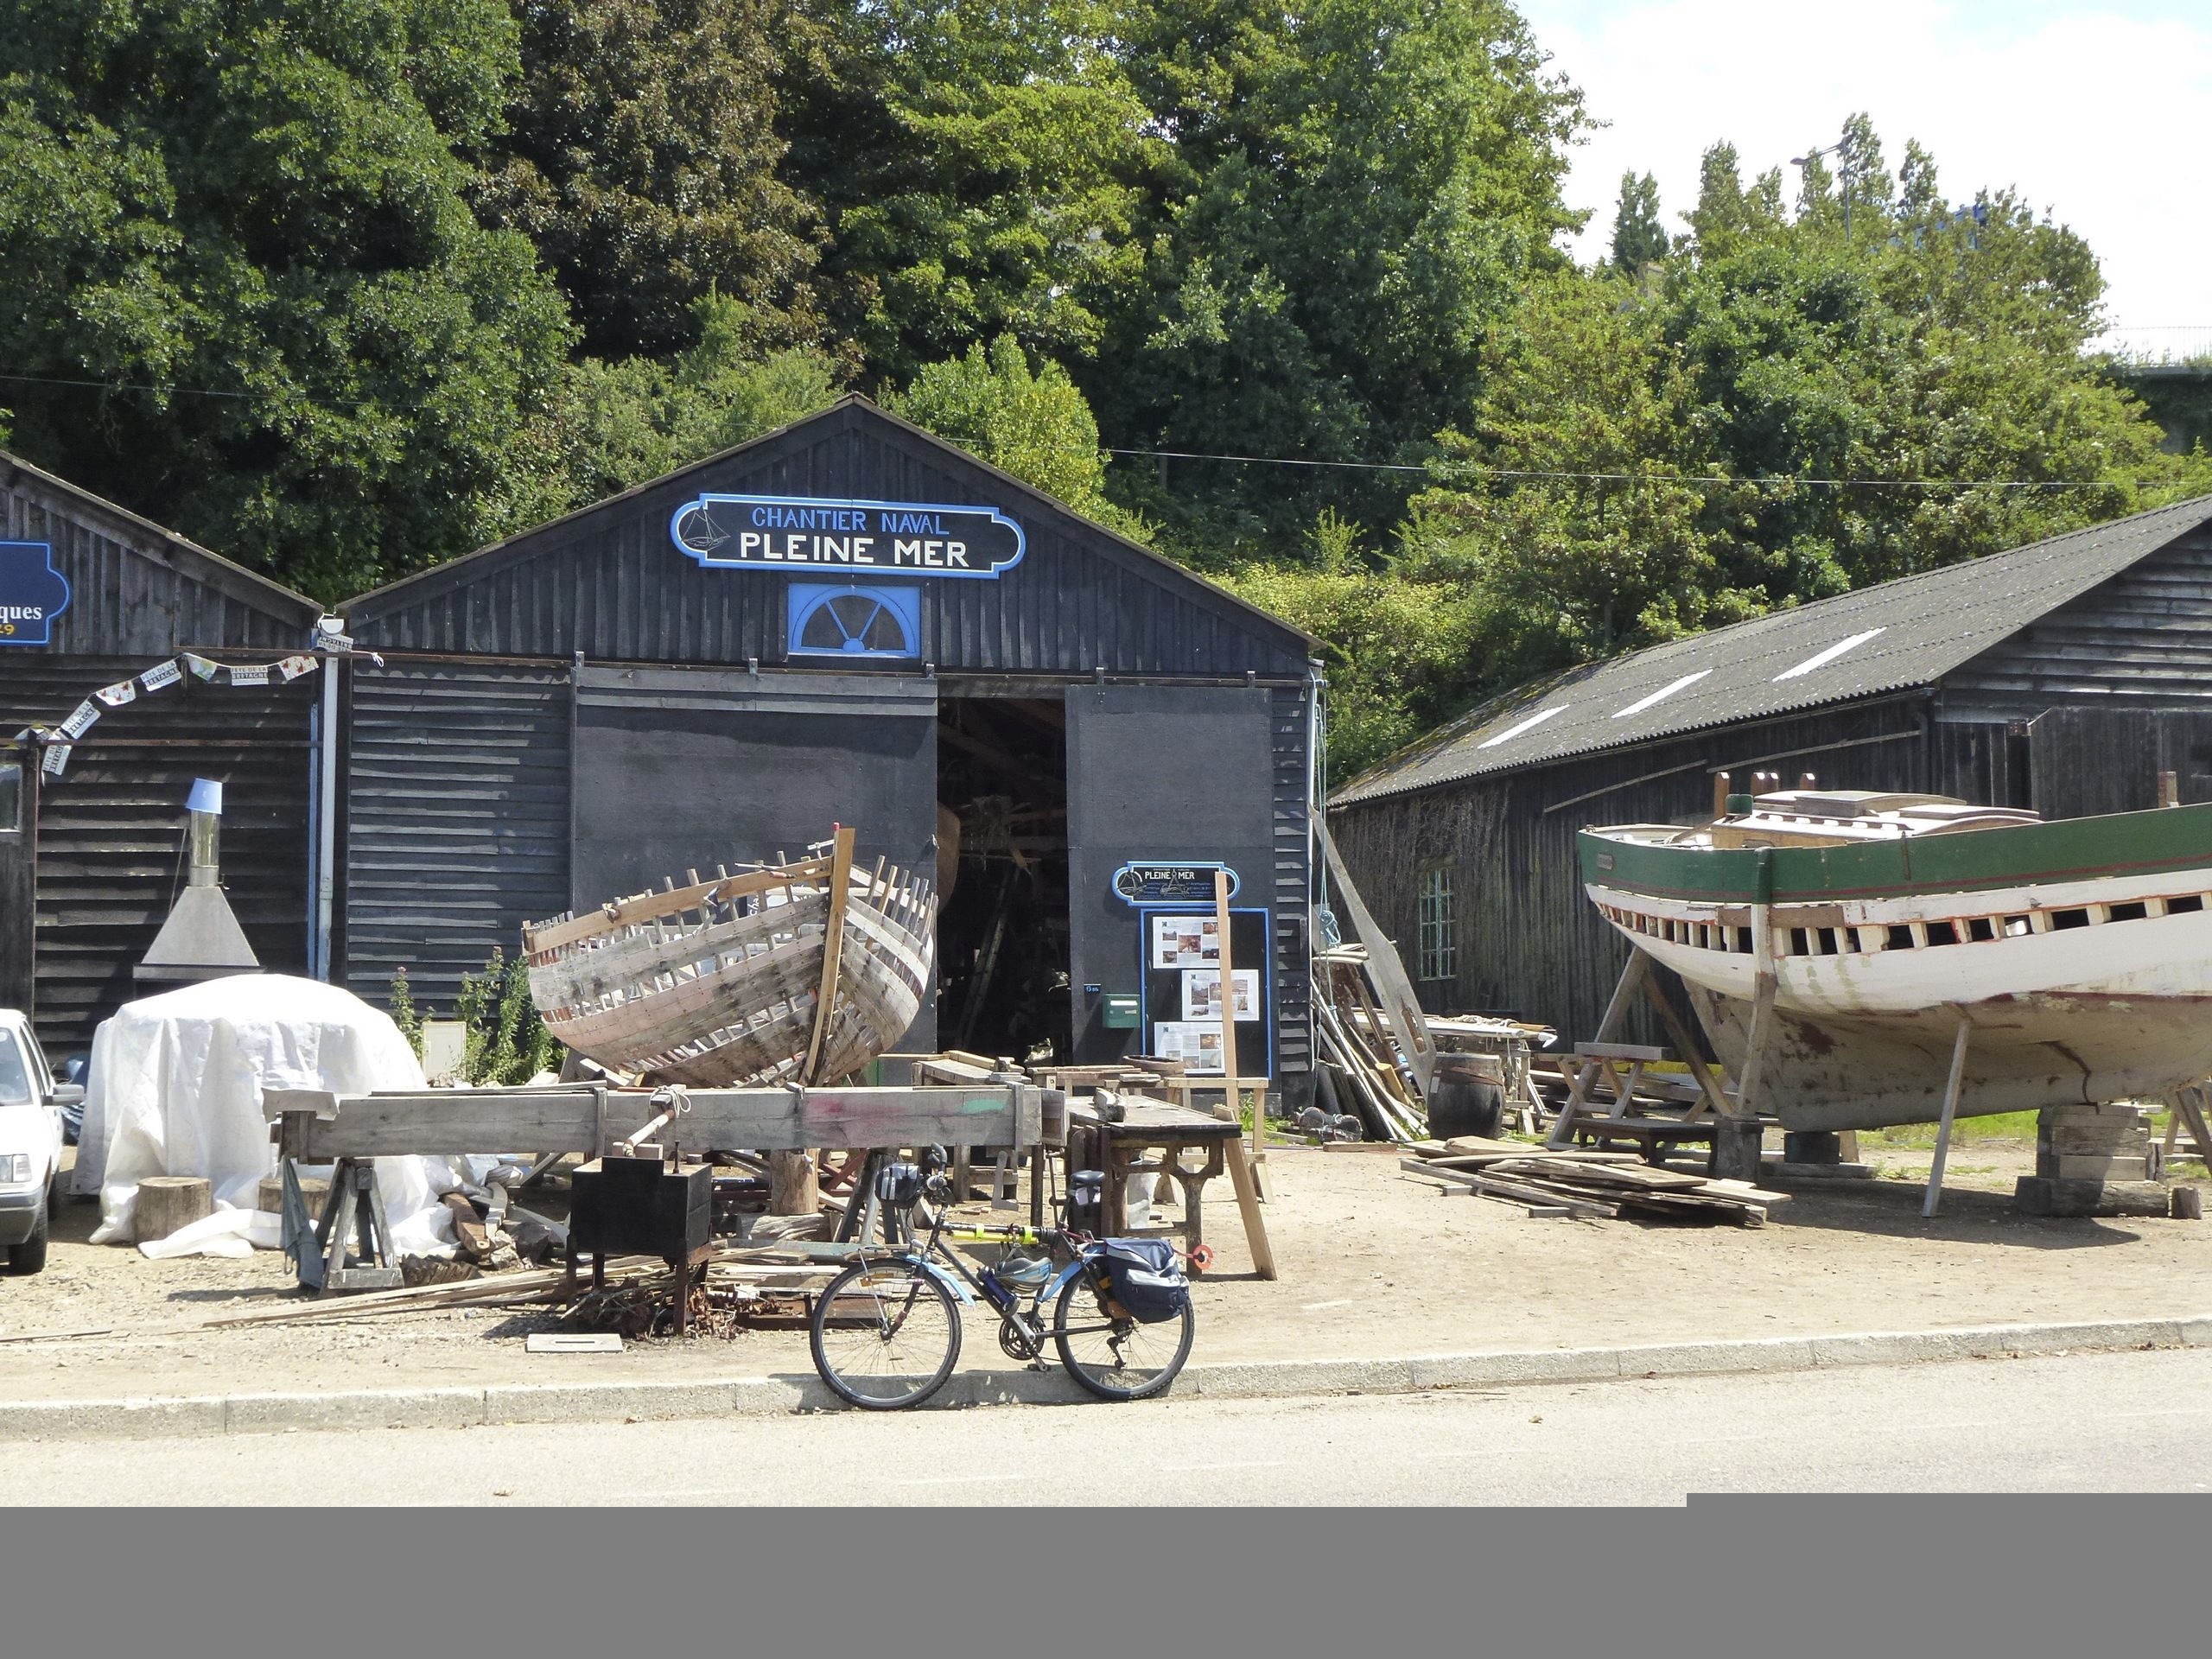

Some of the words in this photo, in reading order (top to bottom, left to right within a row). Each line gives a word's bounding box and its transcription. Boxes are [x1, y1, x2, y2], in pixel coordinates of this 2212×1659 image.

[752, 507, 867, 531] CHANTIER
[881, 512, 950, 535] NAVAL
[740, 532, 874, 563] PLEINE
[894, 539, 969, 568] MER
[145, 667, 180, 687] BRETAGNE
[1145, 871, 1171, 880] PLEINE
[1178, 871, 1195, 880] MER
